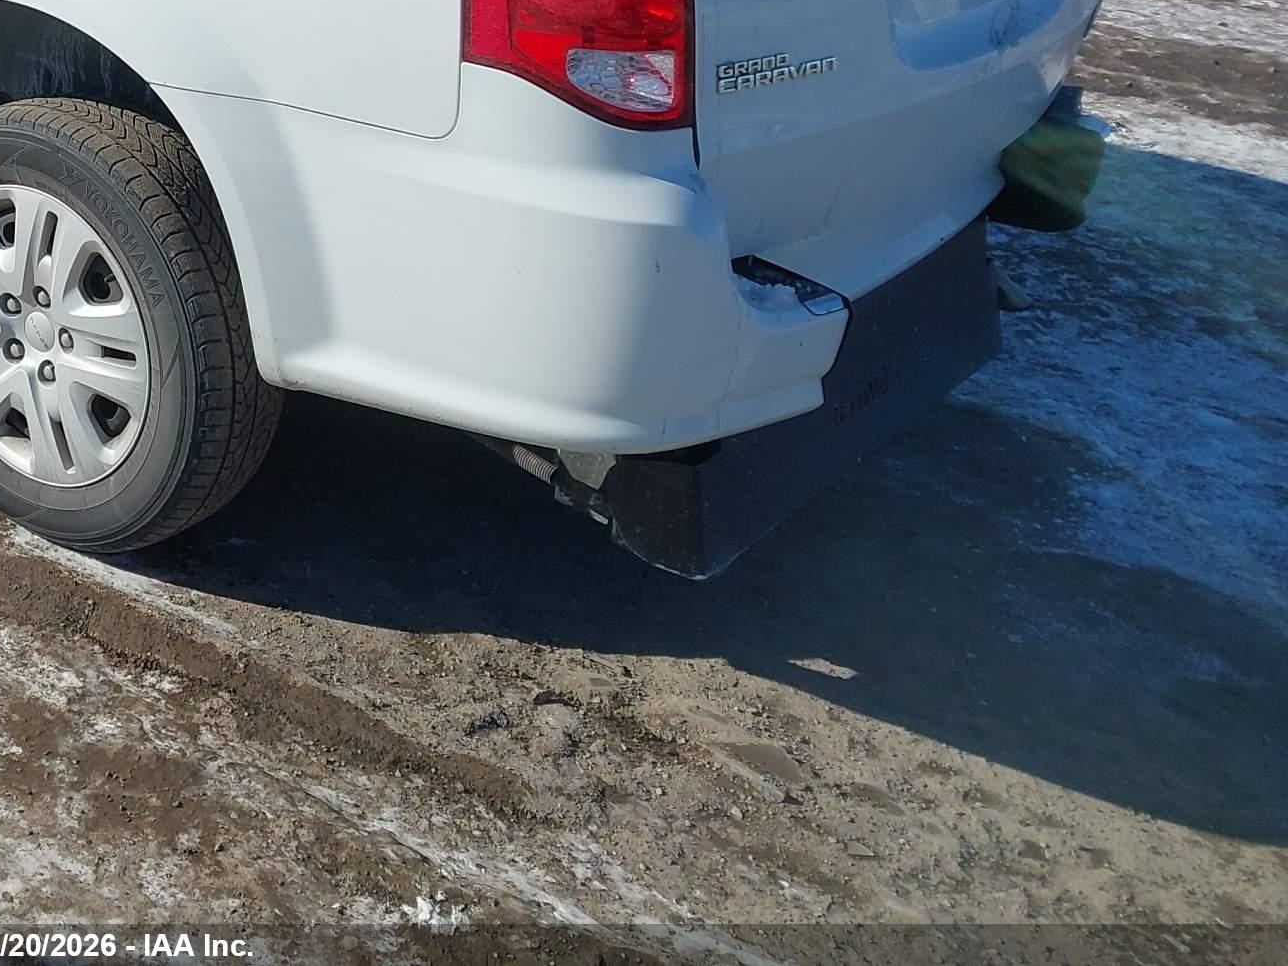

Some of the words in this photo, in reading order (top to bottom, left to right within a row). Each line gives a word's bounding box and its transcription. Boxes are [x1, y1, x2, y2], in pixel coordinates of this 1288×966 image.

[717, 53, 790, 78] GRAND
[718, 56, 838, 94] CARAVAN
[85, 180, 165, 309] YOKOHAMA
